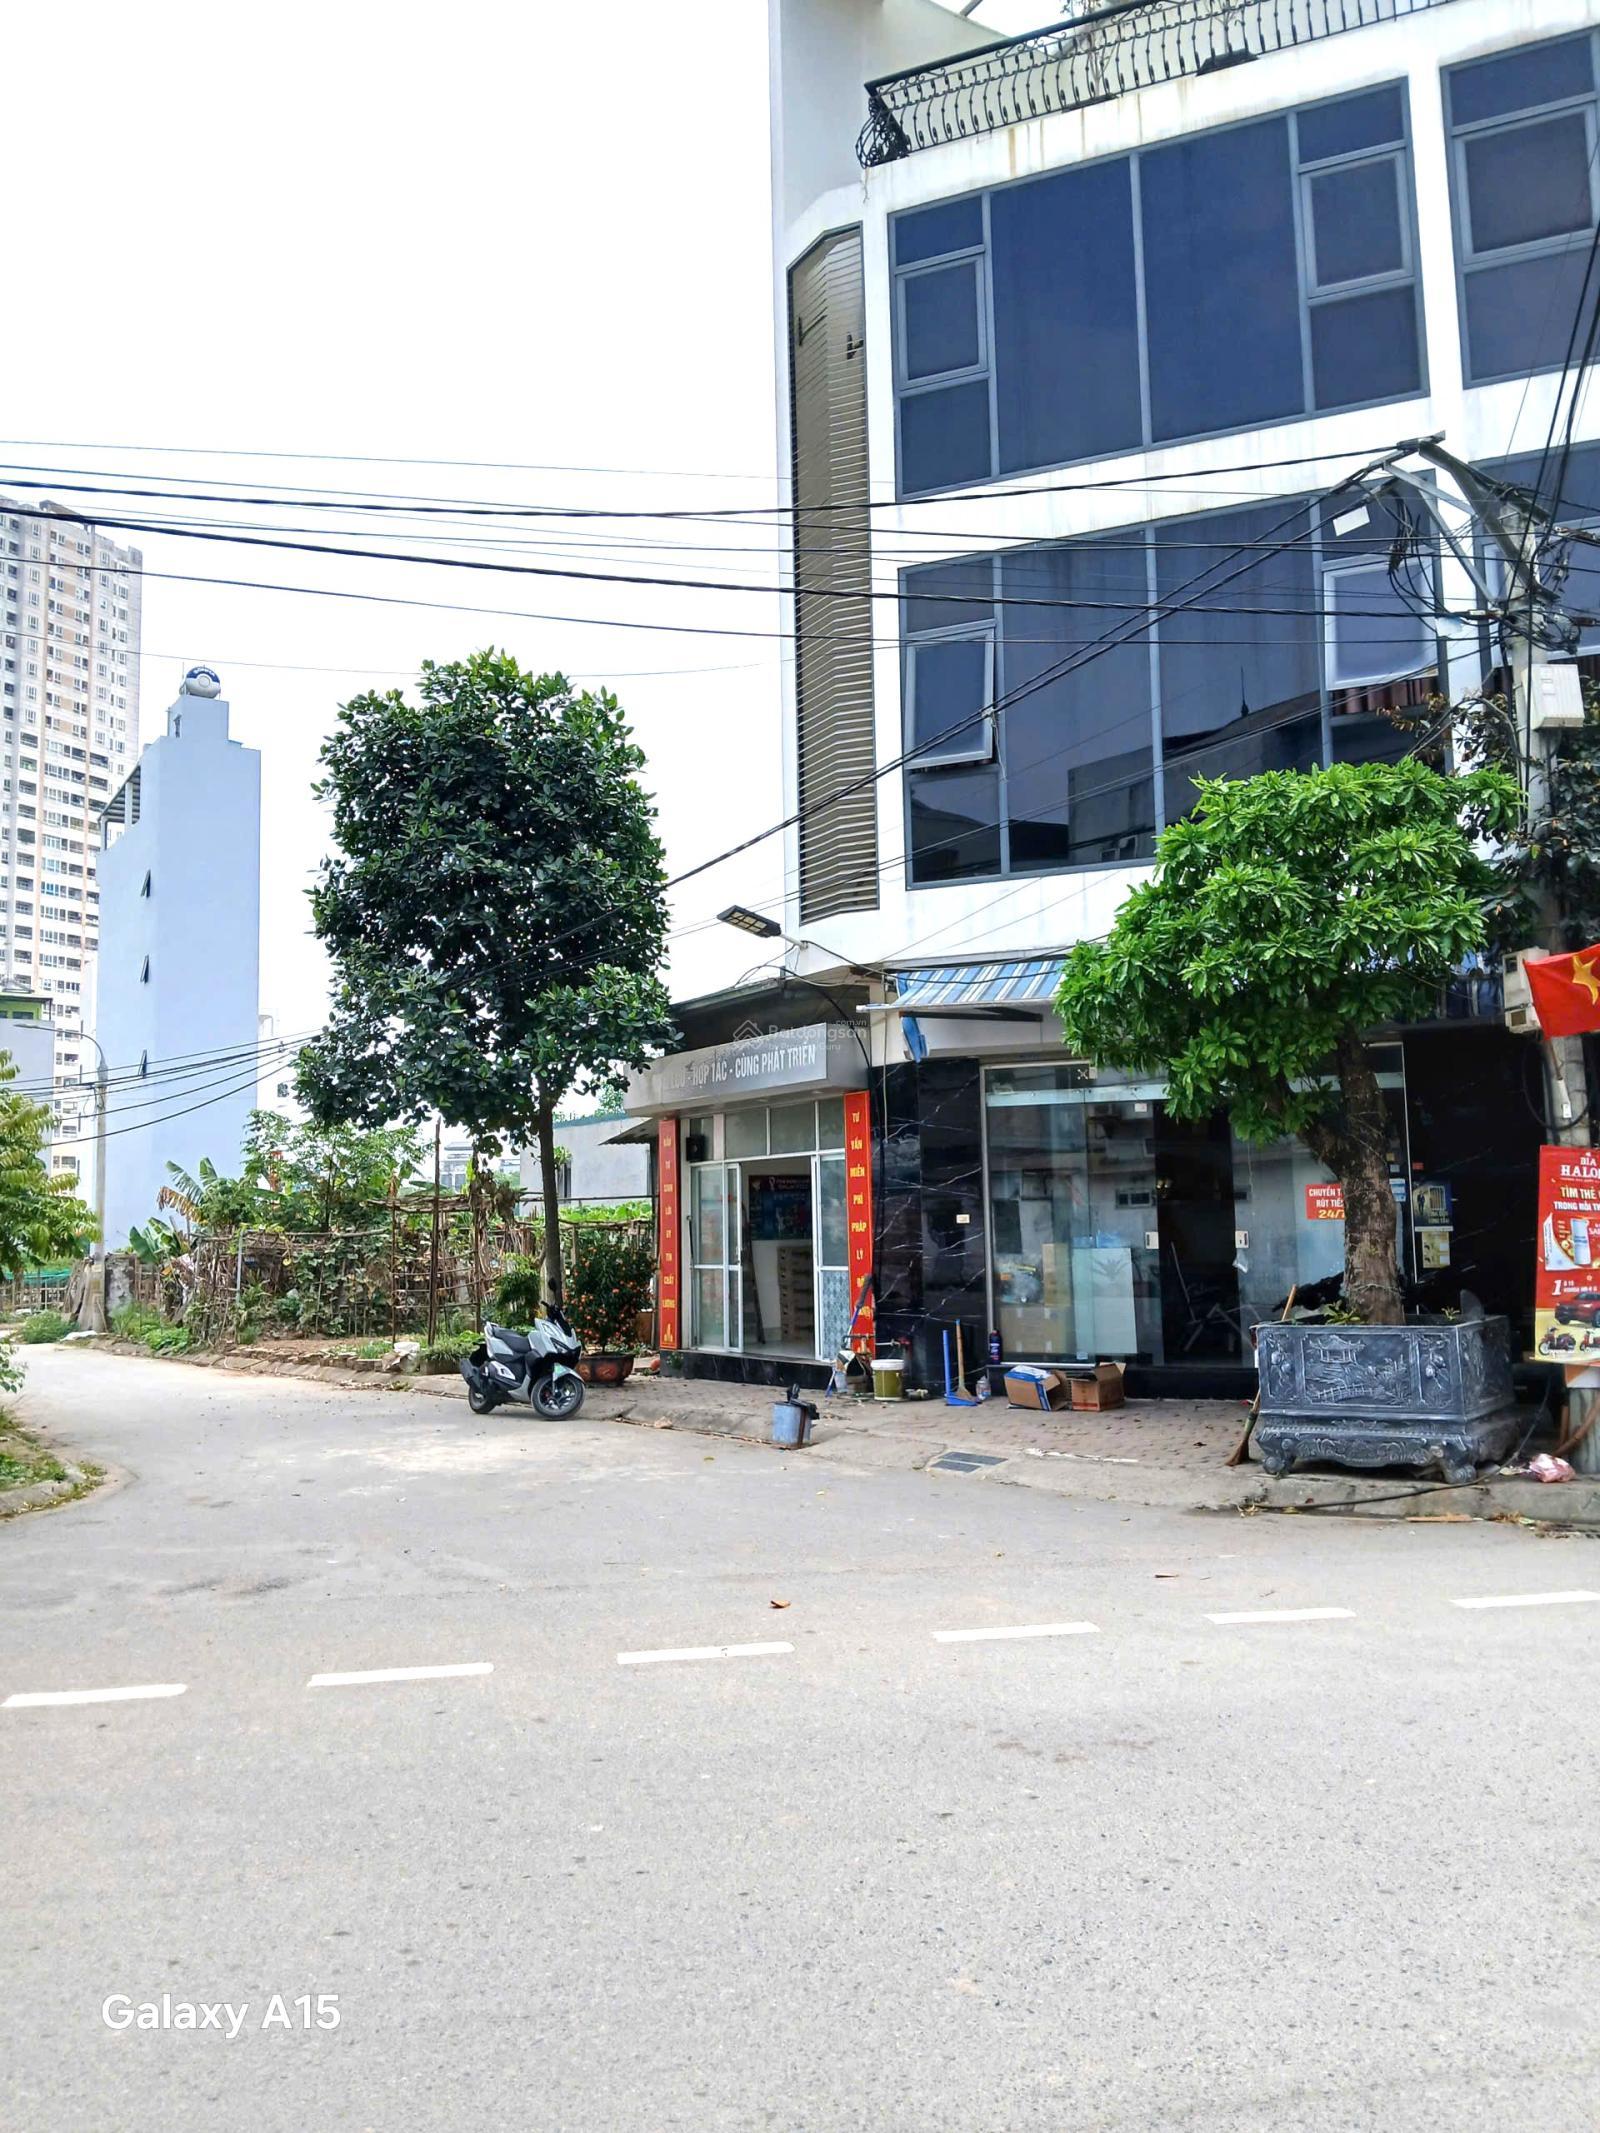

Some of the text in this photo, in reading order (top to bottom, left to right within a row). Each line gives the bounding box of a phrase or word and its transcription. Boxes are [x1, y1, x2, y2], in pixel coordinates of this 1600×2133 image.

[735, 1051, 759, 1079] CÙNG
[761, 1046, 785, 1074] PHÁT
[1553, 1201, 1578, 1210] TRONG
[851, 1219, 867, 1233] PHÁP
[1551, 1279, 1562, 1296] 1
